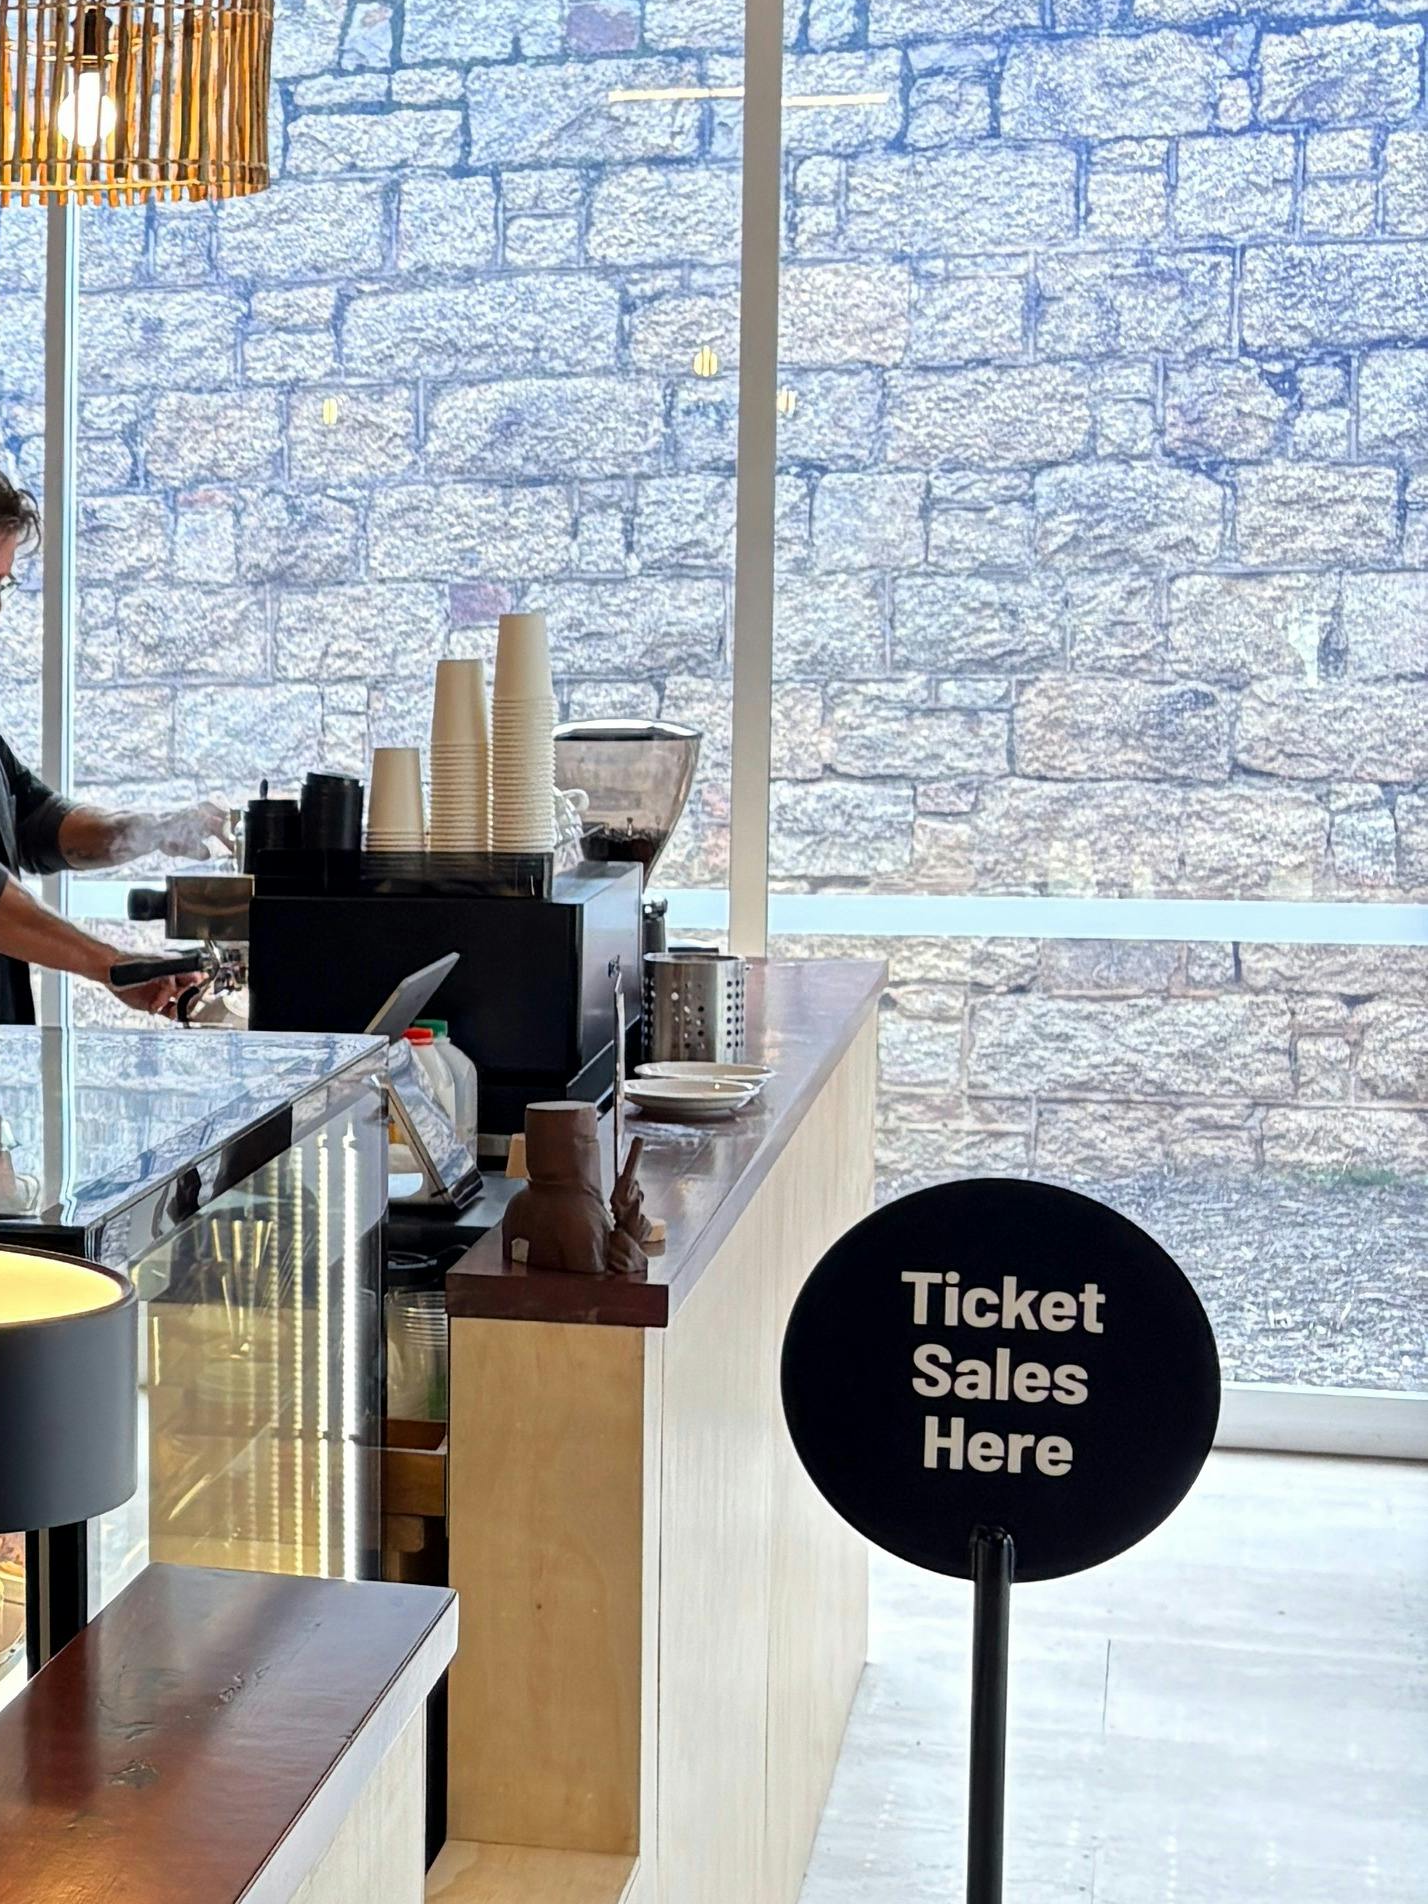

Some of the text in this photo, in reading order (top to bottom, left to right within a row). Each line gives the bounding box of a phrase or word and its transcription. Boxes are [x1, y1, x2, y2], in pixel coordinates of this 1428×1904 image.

[900, 1270, 1107, 1335] Ticket
[911, 1343, 1089, 1406] Sales
[923, 1415, 1074, 1476] Here
